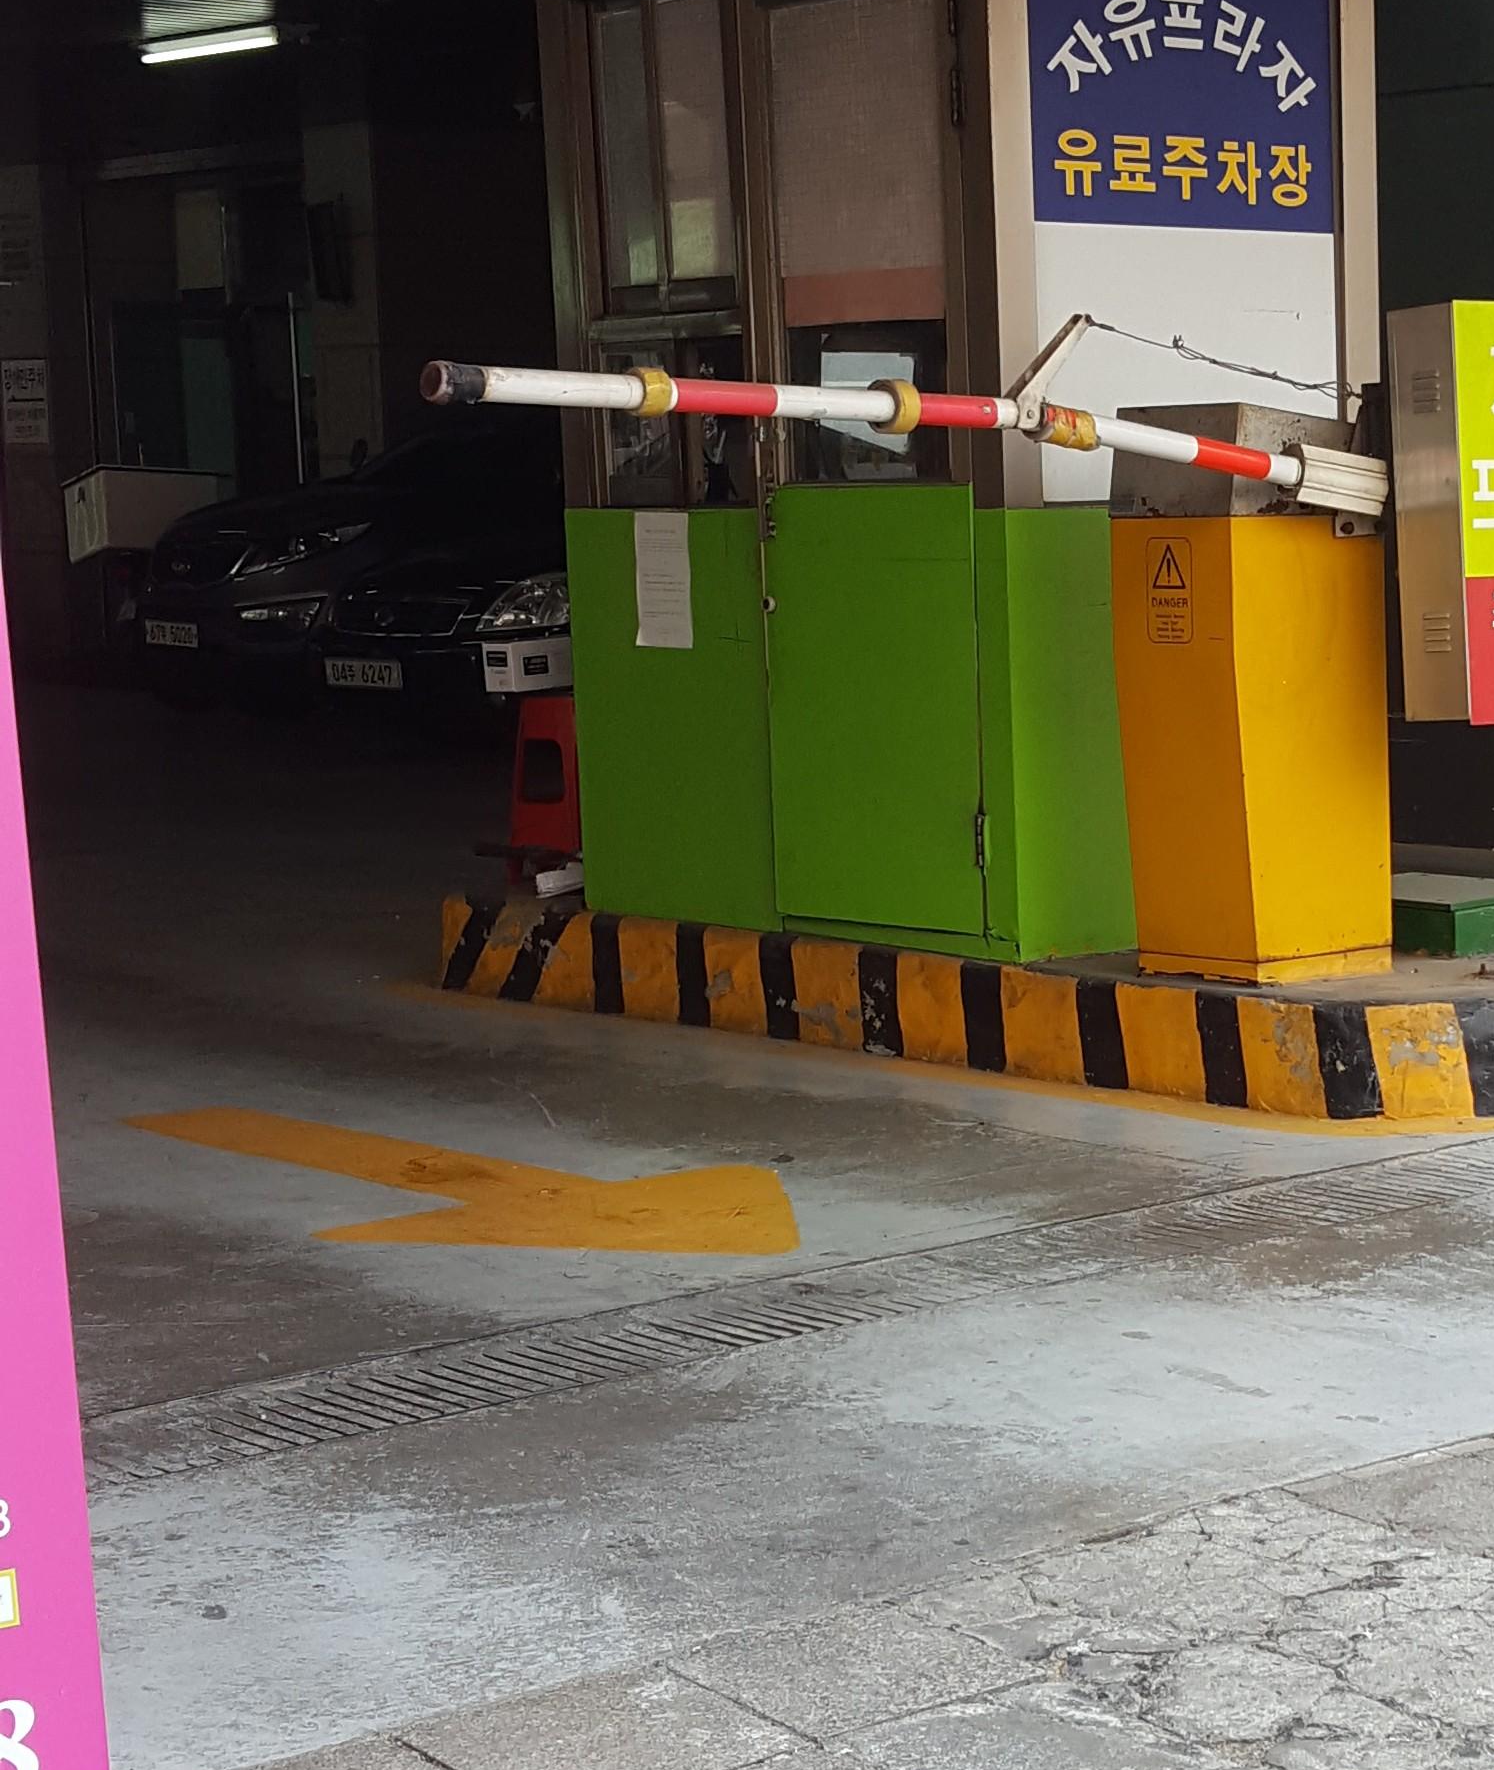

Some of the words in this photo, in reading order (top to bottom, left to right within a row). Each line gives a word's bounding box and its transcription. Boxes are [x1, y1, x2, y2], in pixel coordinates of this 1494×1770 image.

[1053, 129, 1313, 208] 유료주차장
[1151, 596, 1189, 609] DANGER
[361, 663, 392, 685] 6247
